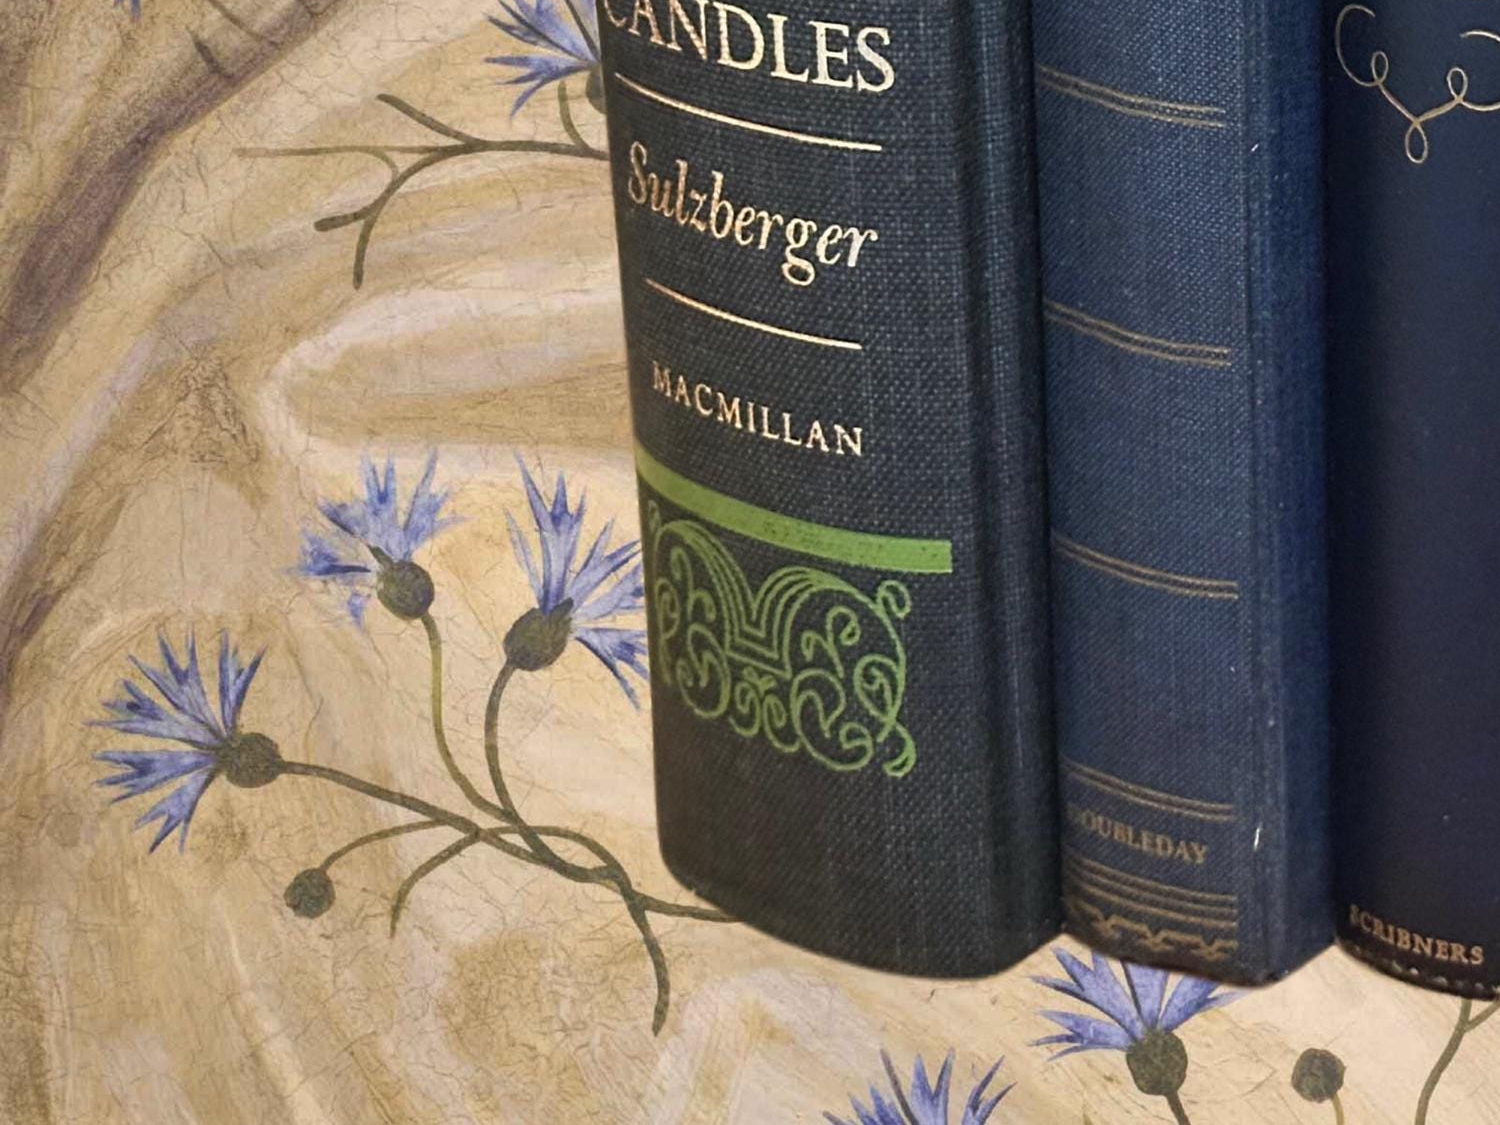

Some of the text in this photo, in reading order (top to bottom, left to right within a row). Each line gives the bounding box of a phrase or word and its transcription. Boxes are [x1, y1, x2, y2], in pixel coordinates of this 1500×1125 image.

[627, 141, 879, 287] Sulzberger
[652, 360, 863, 458] MACMILLAN
[1350, 904, 1484, 965] SCRIBNERS
